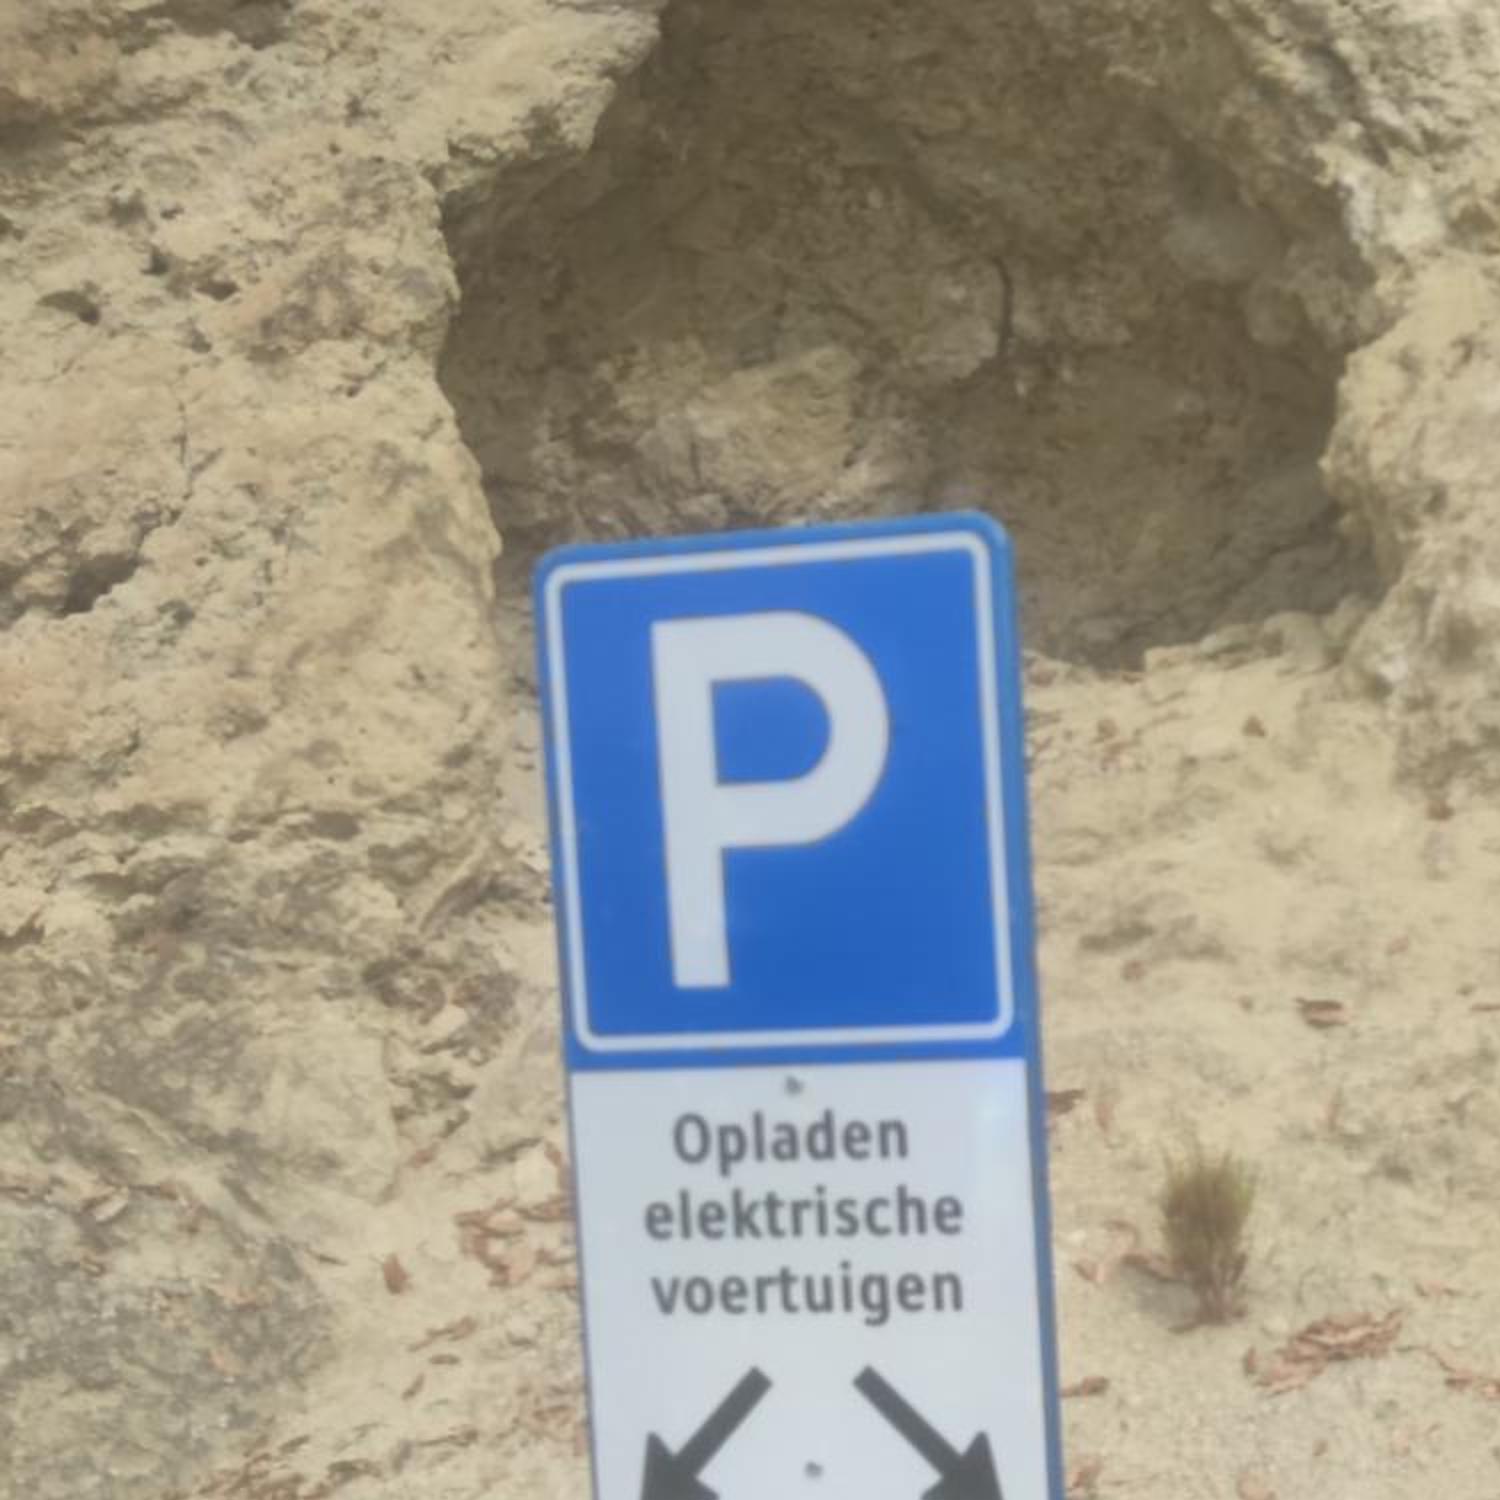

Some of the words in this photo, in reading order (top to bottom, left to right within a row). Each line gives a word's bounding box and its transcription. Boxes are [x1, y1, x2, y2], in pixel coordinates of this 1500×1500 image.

[651, 610, 890, 989] P
[672, 1109, 909, 1178] Opladen
[644, 1185, 964, 1240] elektrische
[650, 1260, 964, 1328] voertuigen
